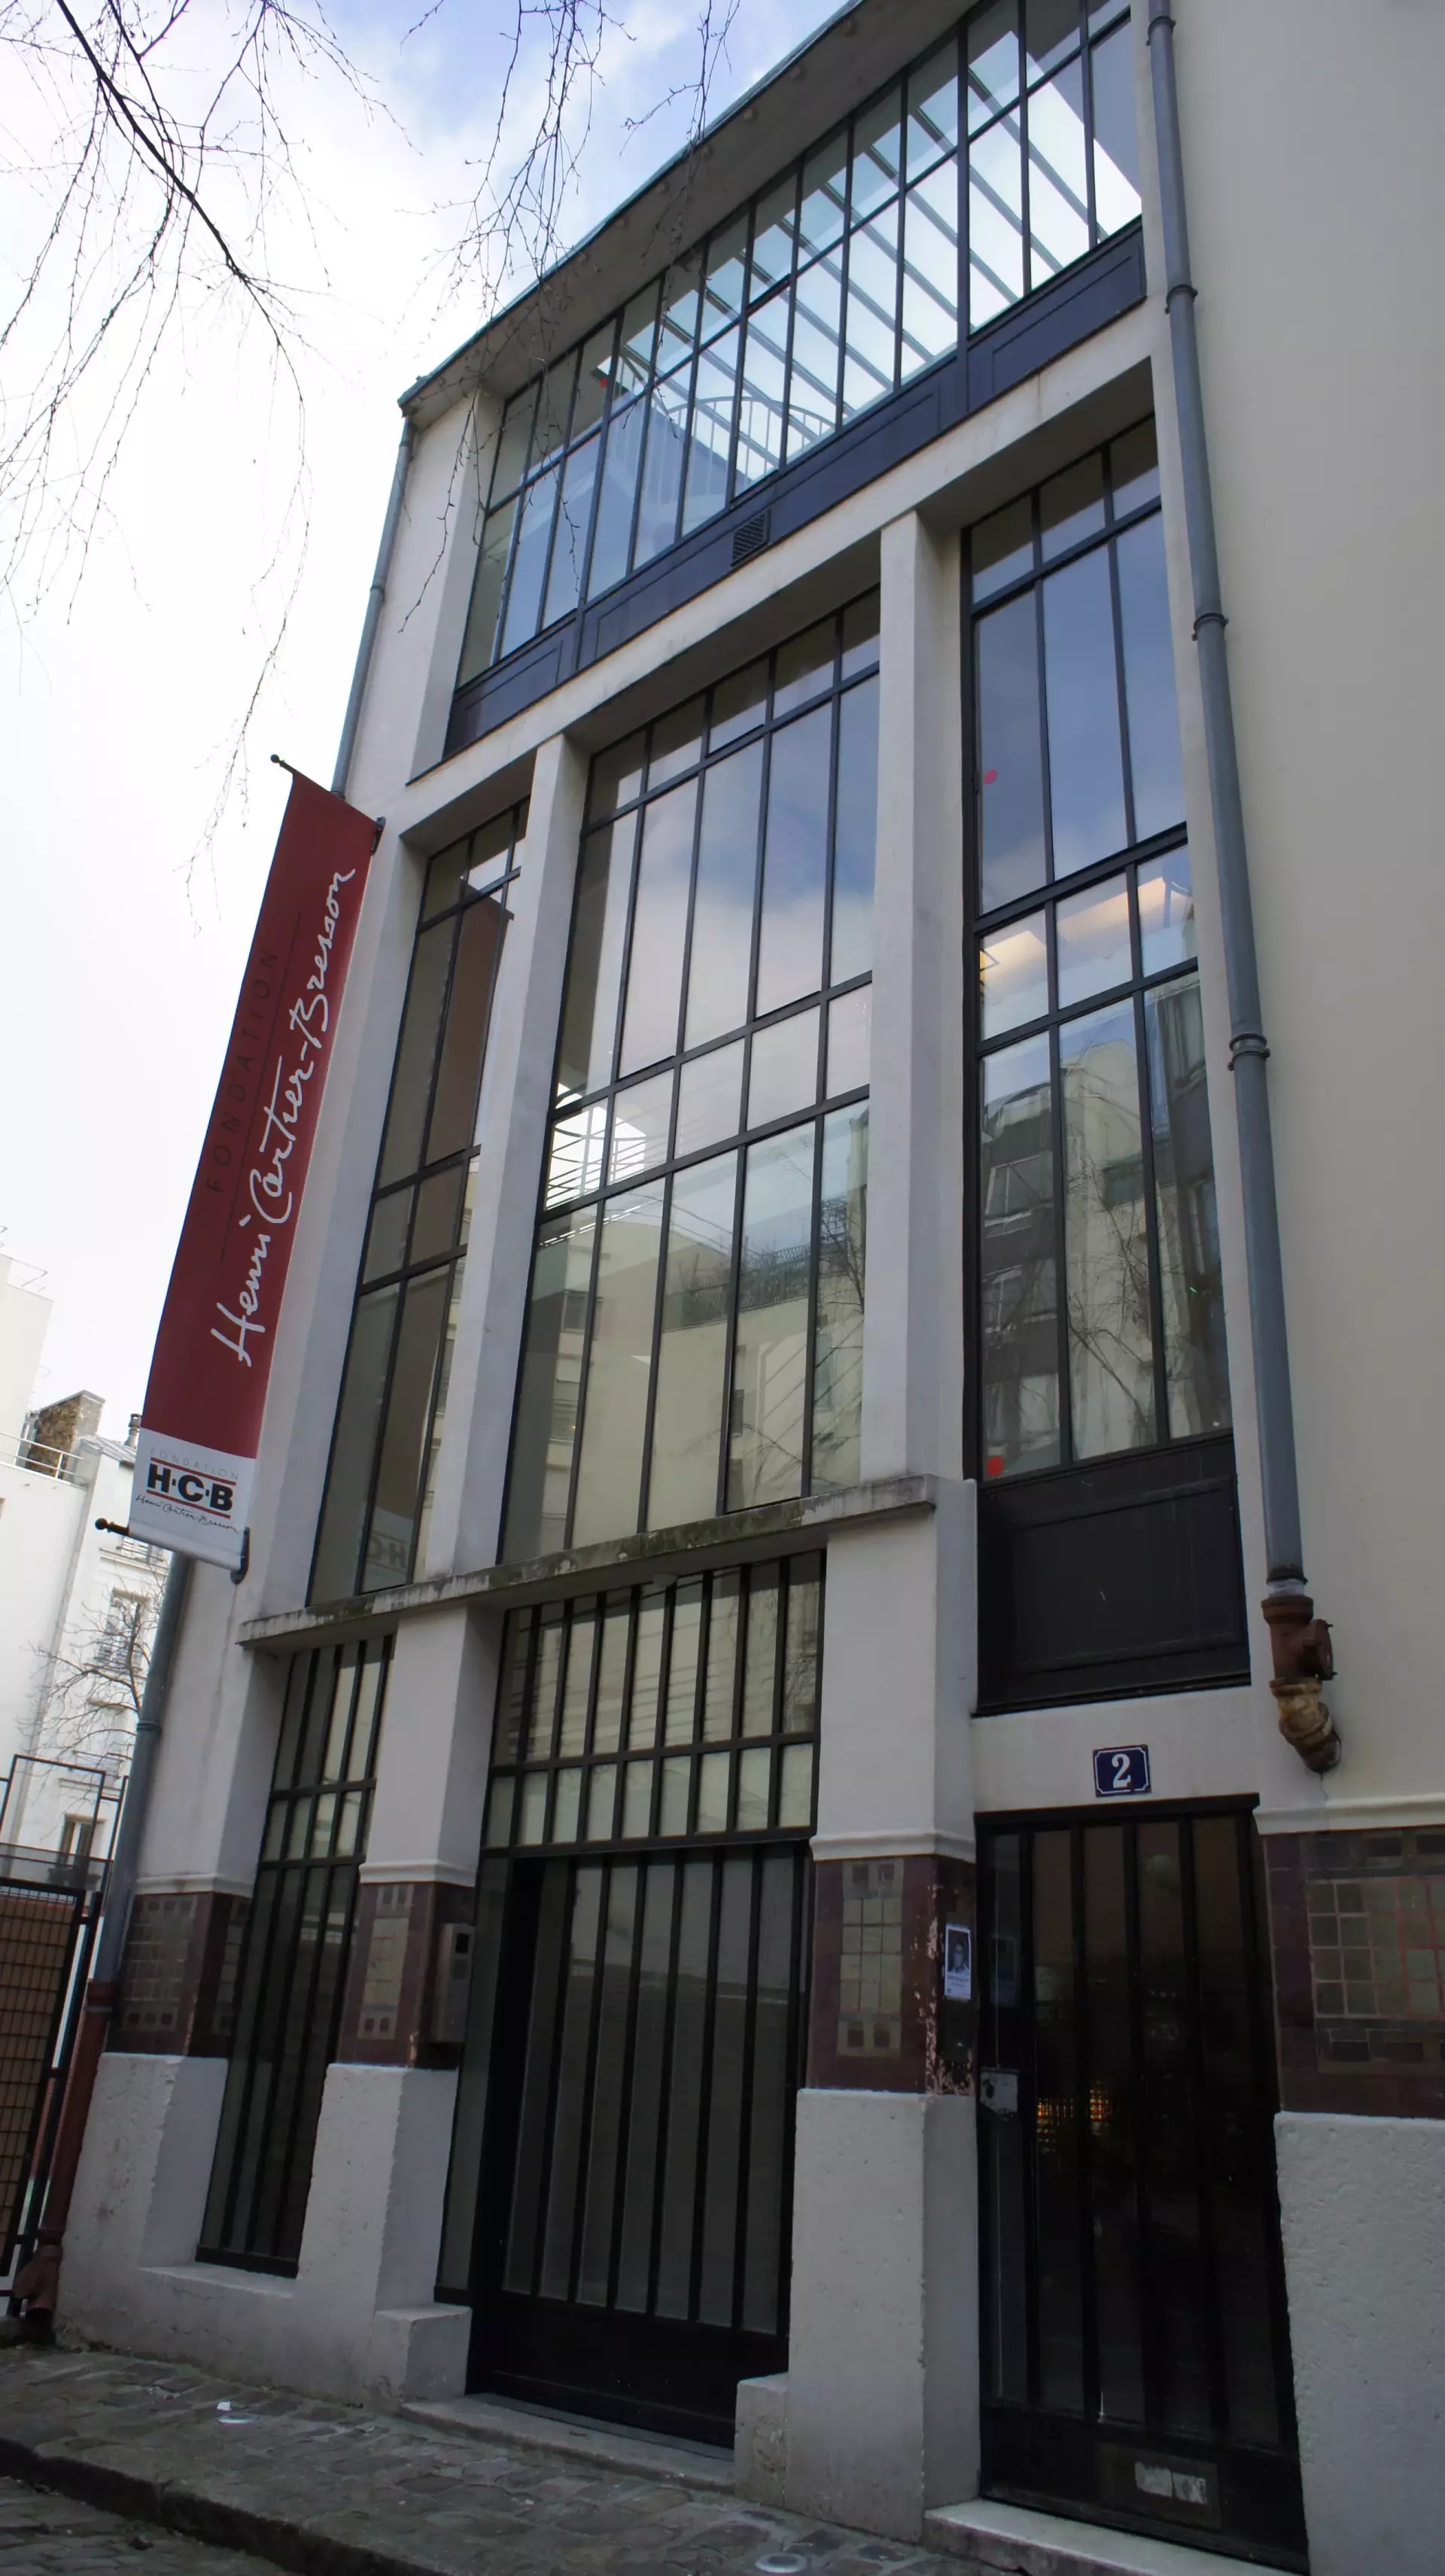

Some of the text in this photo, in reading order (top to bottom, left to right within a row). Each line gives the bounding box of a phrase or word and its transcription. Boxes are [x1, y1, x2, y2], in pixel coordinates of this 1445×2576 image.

[206, 946, 278, 1193] FONDATION
[211, 868, 356, 1367] Henri Cartier-Bresson
[151, 1447, 239, 1480] FONDATION
[1112, 1753, 1130, 1788] 2
